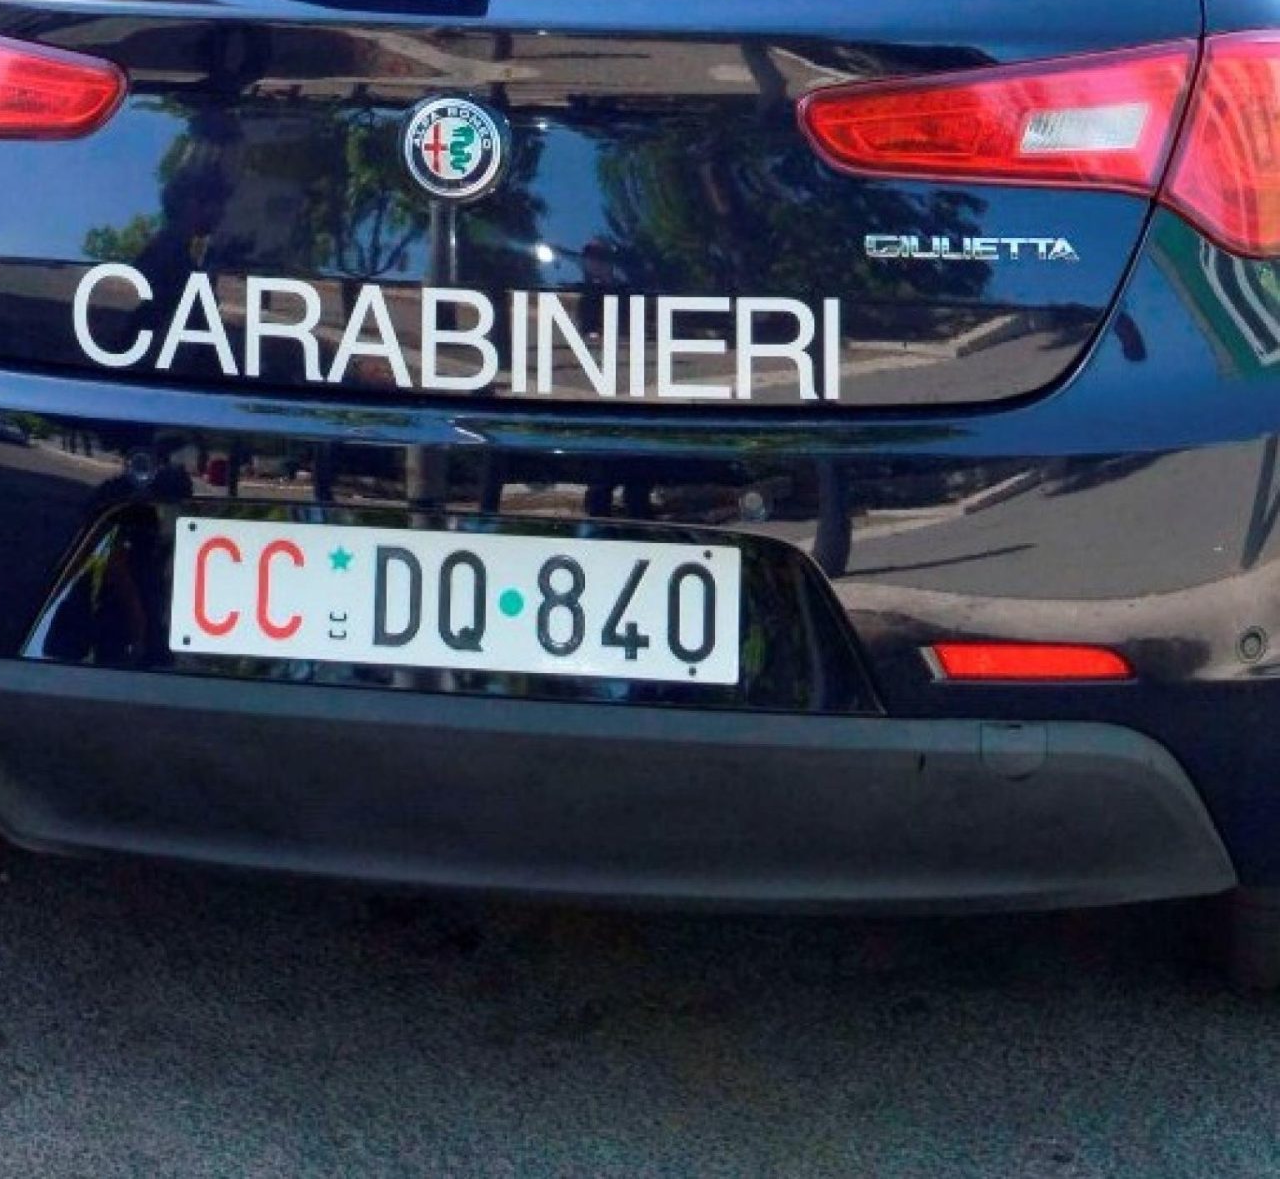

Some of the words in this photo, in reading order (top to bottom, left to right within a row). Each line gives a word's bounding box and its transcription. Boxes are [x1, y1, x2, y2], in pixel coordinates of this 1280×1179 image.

[865, 235, 1081, 261] GIULIETTA
[73, 263, 842, 400] CARABINIERI
[194, 537, 304, 639] CC
[537, 556, 716, 664] 840
